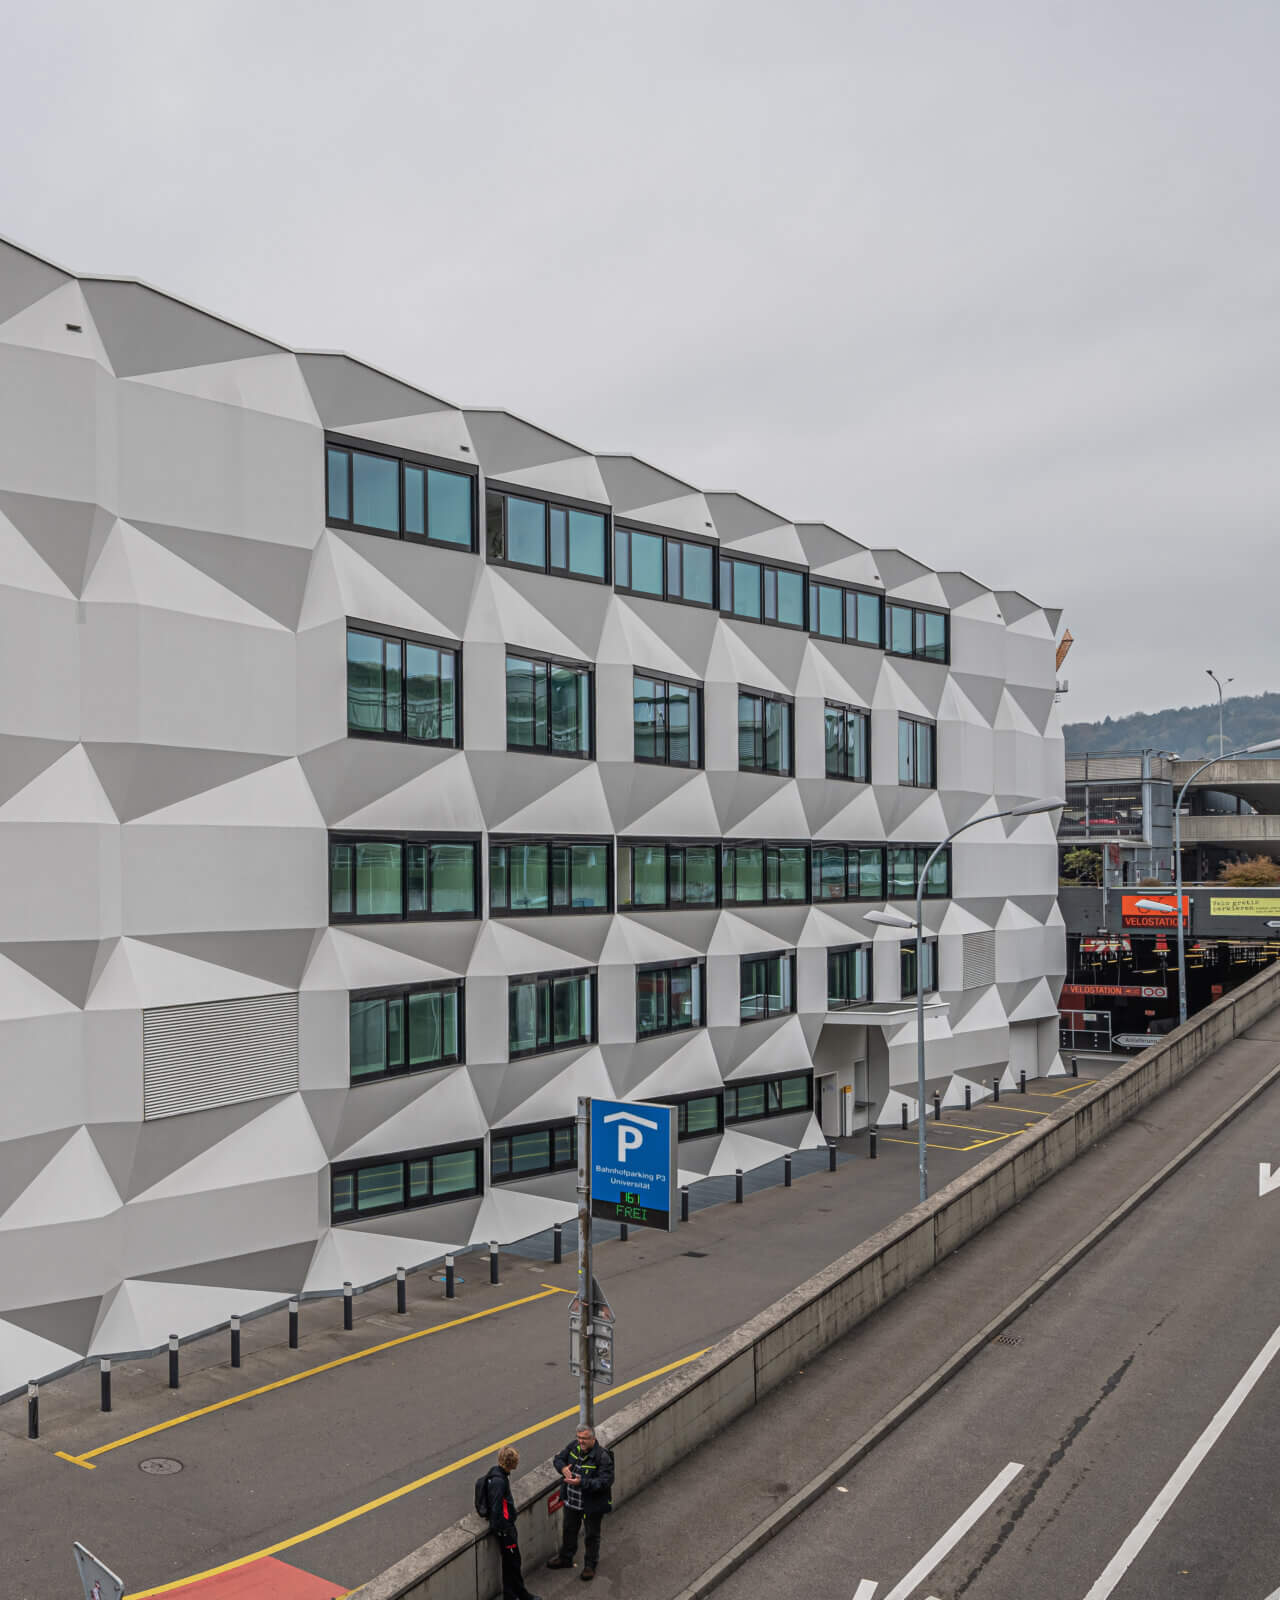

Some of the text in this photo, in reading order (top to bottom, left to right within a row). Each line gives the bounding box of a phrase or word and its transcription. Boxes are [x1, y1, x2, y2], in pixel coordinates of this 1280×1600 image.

[1070, 985, 1122, 995] VELOSTATION
[618, 1124, 643, 1162] P
[595, 1165, 666, 1182] Bahnhofparking P3
[610, 1177, 651, 1190] Universität
[616, 1204, 648, 1221] FREI
